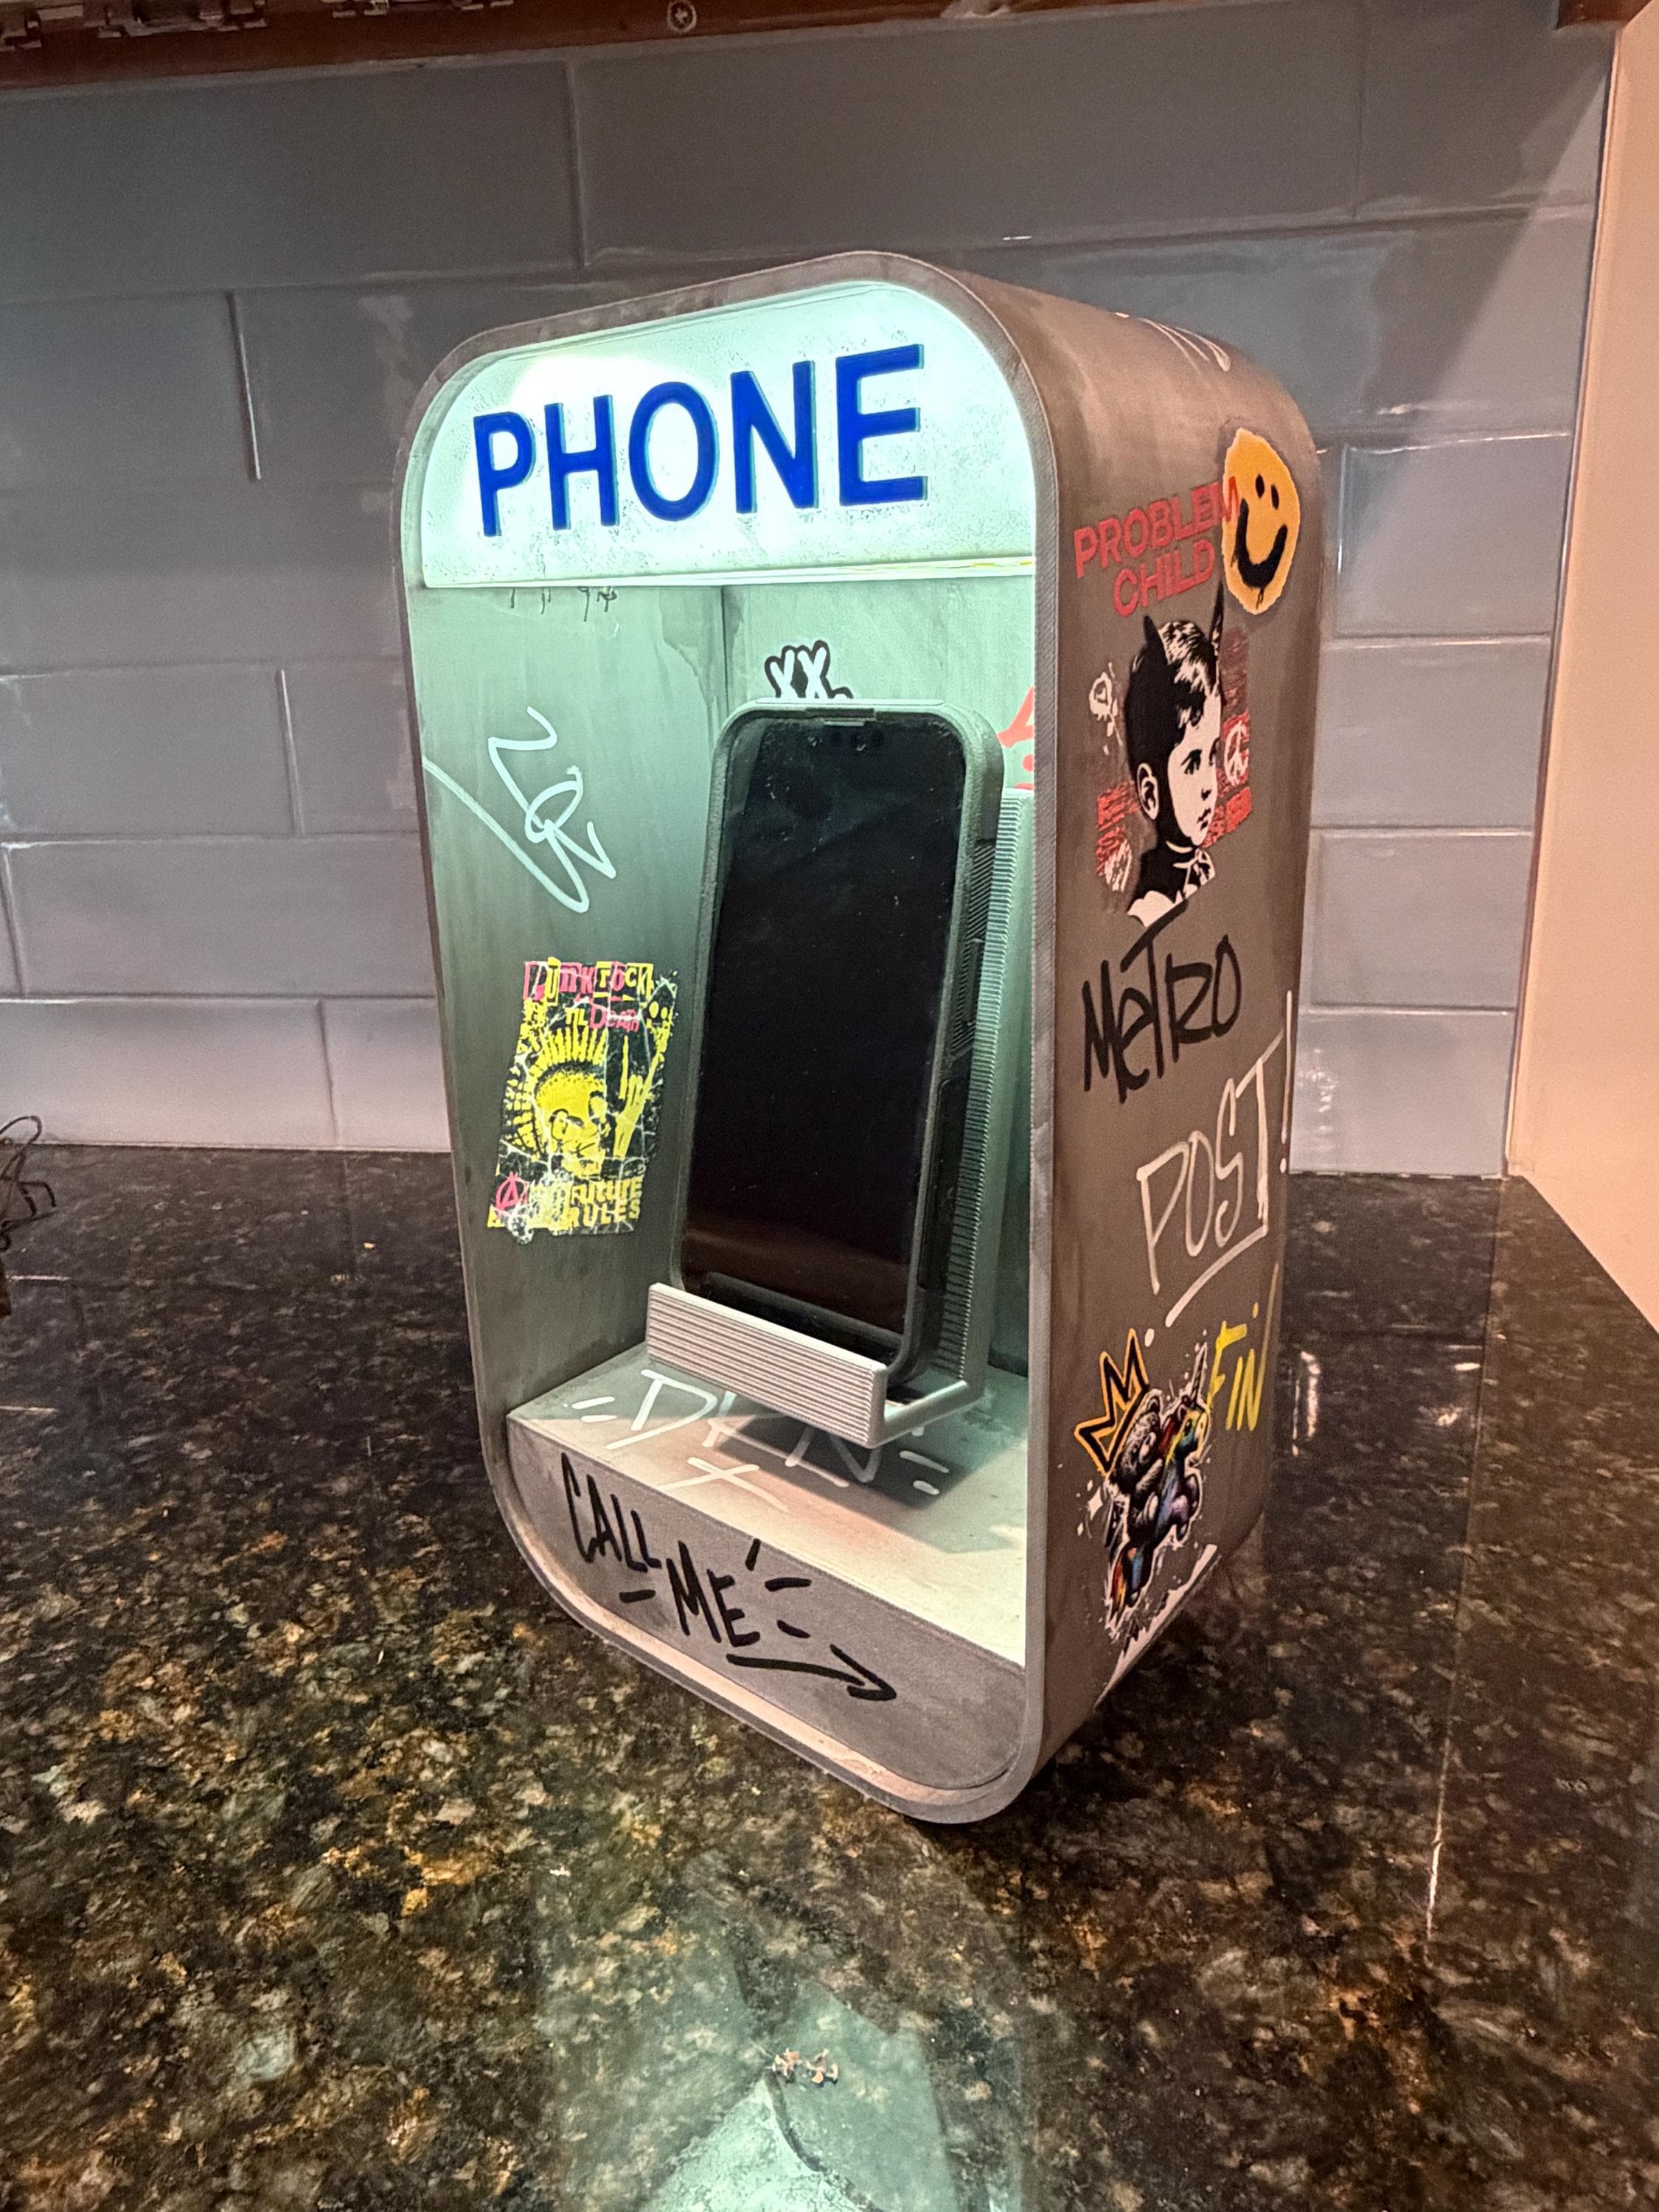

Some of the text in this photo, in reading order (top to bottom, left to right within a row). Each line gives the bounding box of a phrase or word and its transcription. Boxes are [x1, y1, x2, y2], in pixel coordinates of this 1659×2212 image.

[473, 344, 928, 537] PHONE
[1074, 476, 1240, 580] PROBLEM
[1113, 538, 1216, 618] CHILD
[561, 1452, 760, 1647] CALL ME
